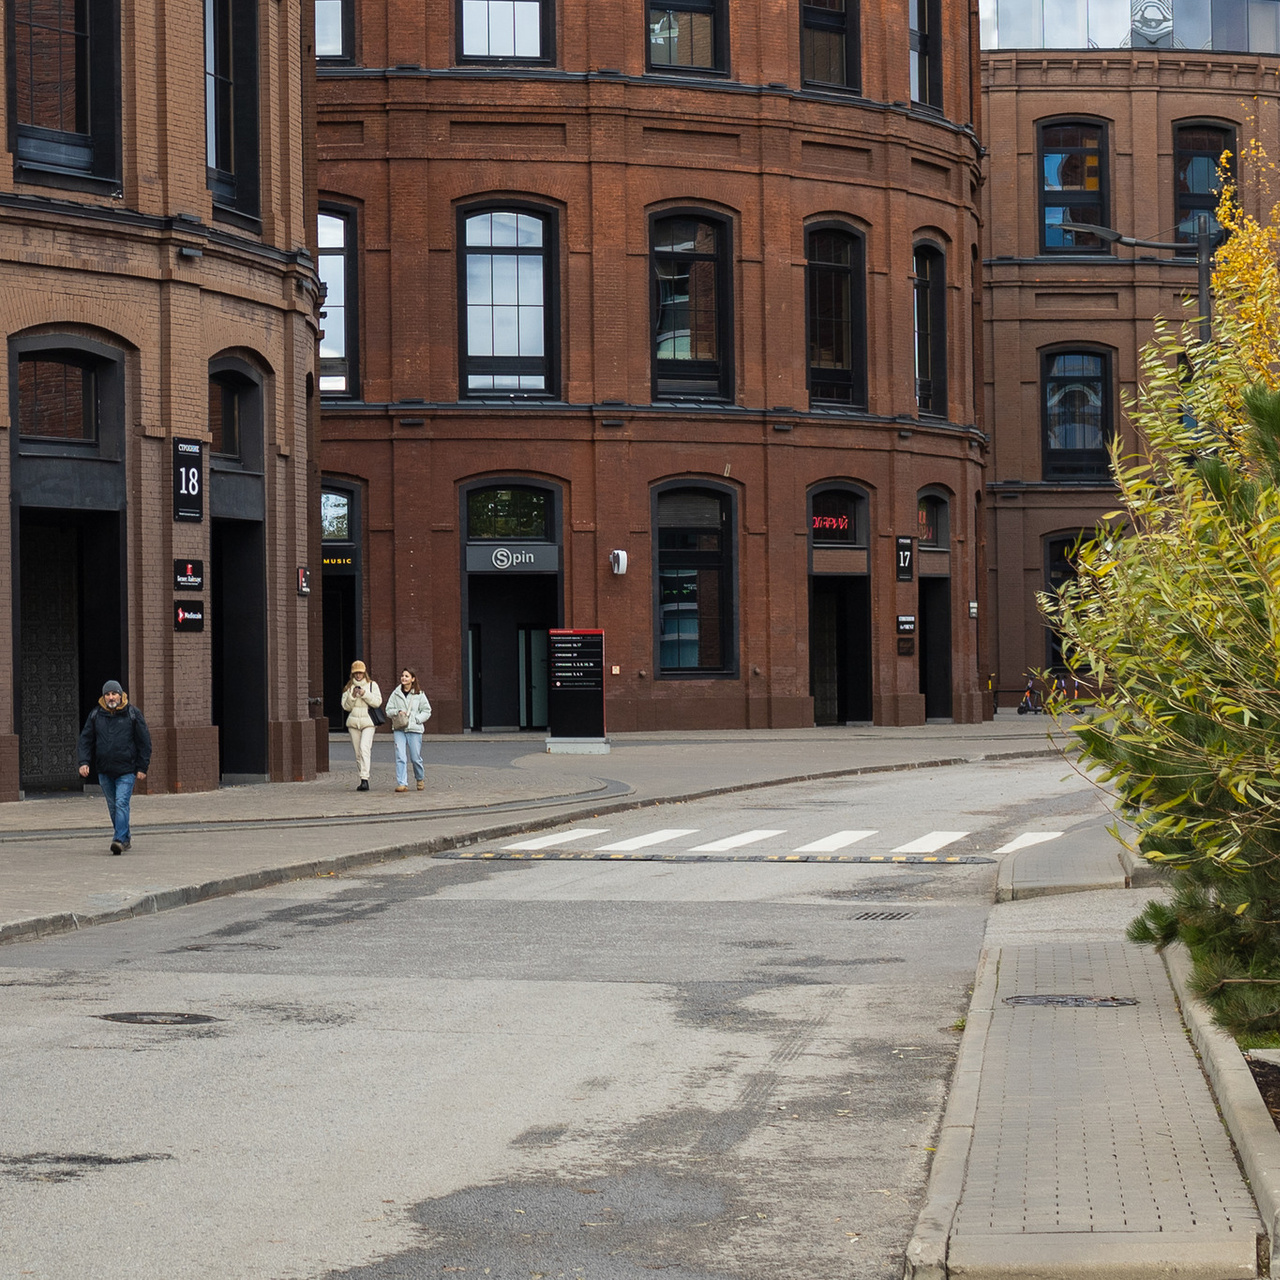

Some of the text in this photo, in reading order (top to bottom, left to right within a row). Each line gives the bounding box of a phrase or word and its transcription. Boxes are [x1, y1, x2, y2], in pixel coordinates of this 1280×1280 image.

[180, 467, 198, 495] 18
[492, 548, 534, 568] Spin
[900, 551, 910, 567] 17
